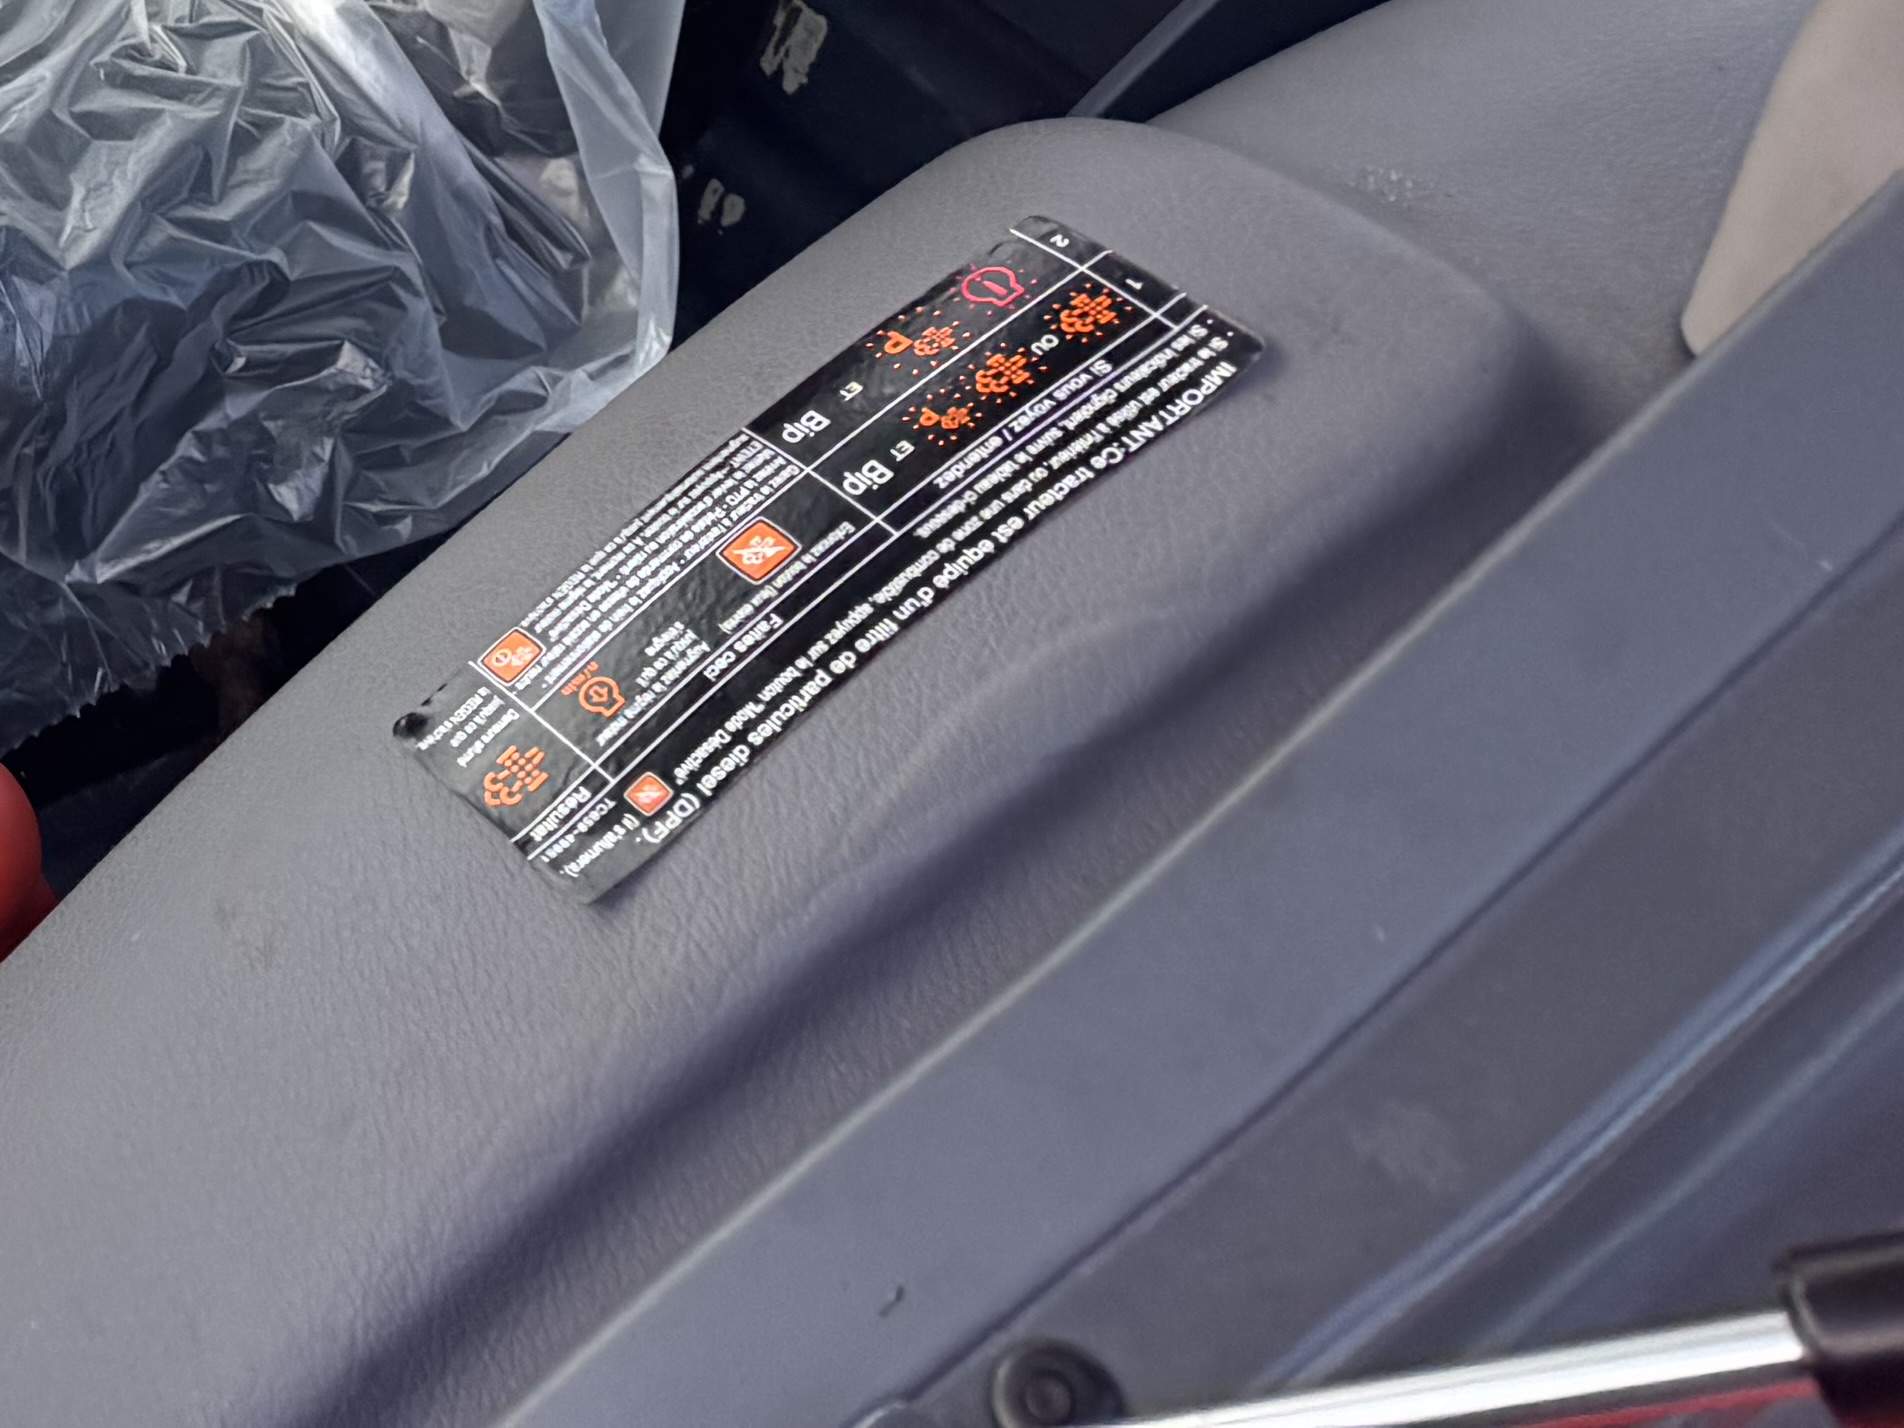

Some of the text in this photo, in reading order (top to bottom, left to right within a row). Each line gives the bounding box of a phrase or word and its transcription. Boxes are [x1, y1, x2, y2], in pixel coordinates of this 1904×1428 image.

[1050, 234, 1069, 249] 2
[1031, 335, 1058, 355] OU
[1189, 325, 1207, 337] Si
[1209, 337, 1228, 351] Si
[1090, 360, 1112, 376] Si
[1053, 374, 1092, 400] vous
[782, 382, 863, 443] ET Bip
[1008, 399, 1056, 432] voyez
[843, 441, 914, 507] ET Bip
[934, 436, 1002, 488] entendez
[1001, 479, 1032, 503] dans
[1023, 467, 1094, 520] tracteur
[980, 500, 1005, 519] une
[952, 516, 983, 541] zone
[991, 517, 1024, 543] est
[936, 538, 955, 553] de
[933, 540, 994, 588] équipé
[893, 587, 934, 620] d'un
[824, 603, 873, 644] appuyez
[855, 619, 898, 652] filtre
[704, 614, 783, 681] Faites ceci
[795, 657, 813, 669] le
[808, 641, 829, 660] sur
[830, 652, 856, 673] de
[758, 667, 801, 701] bouton
[748, 669, 832, 745] particules
[697, 745, 750, 796] diesel
[530, 787, 591, 841] Résultat
[636, 793, 700, 843] (DPF).
